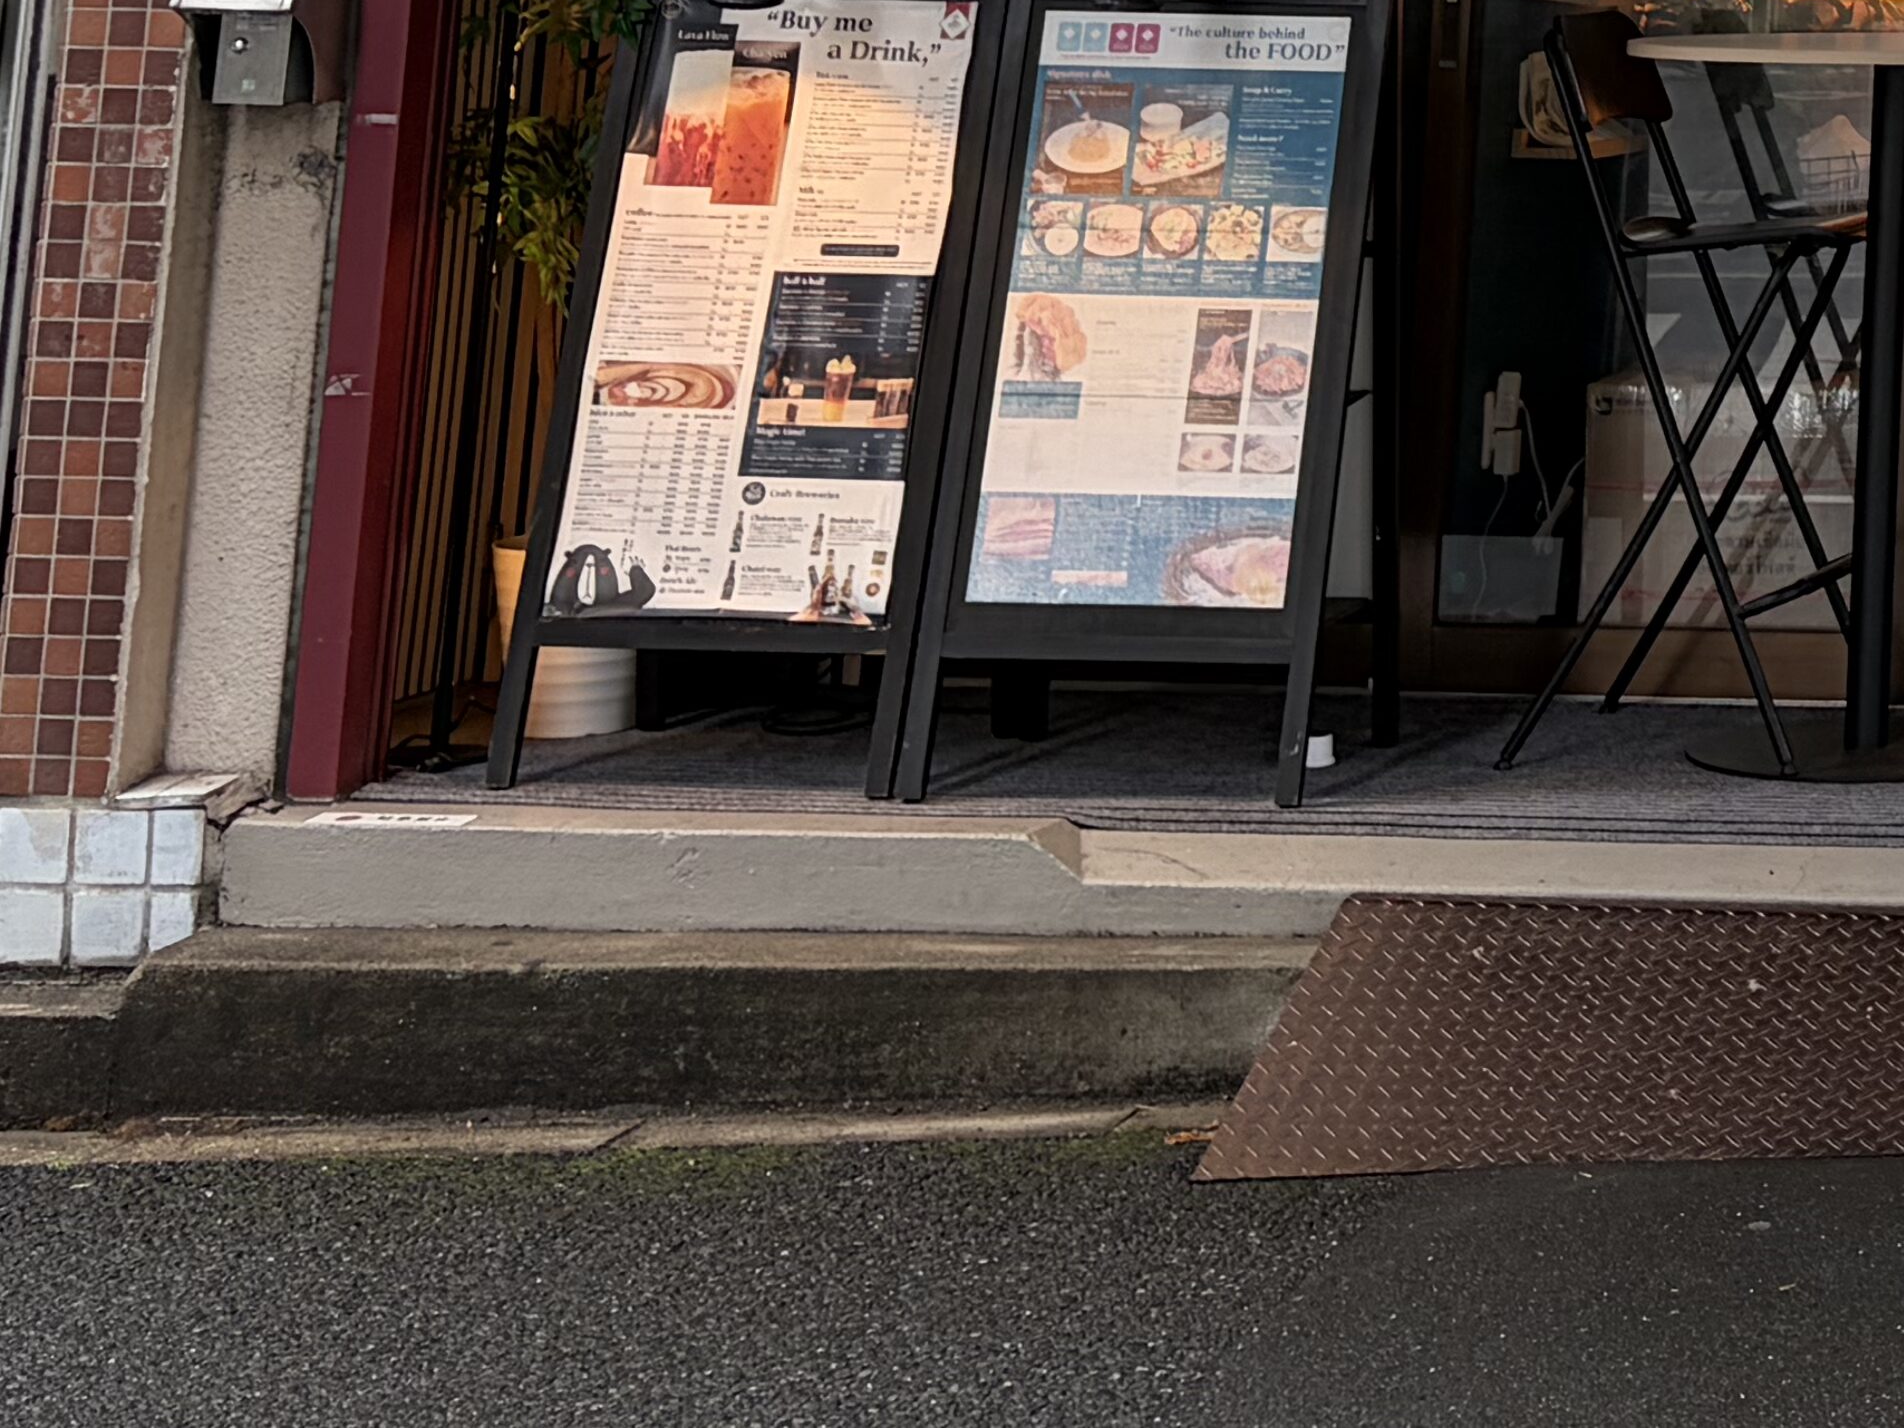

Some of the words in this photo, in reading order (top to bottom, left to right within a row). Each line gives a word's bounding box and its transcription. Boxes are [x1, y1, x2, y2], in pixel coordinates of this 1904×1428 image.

[833, 15, 873, 33] me
[1205, 26, 1255, 40] culture
[1259, 26, 1306, 41] behind
[827, 44, 841, 60] a
[1224, 41, 1261, 60] the
